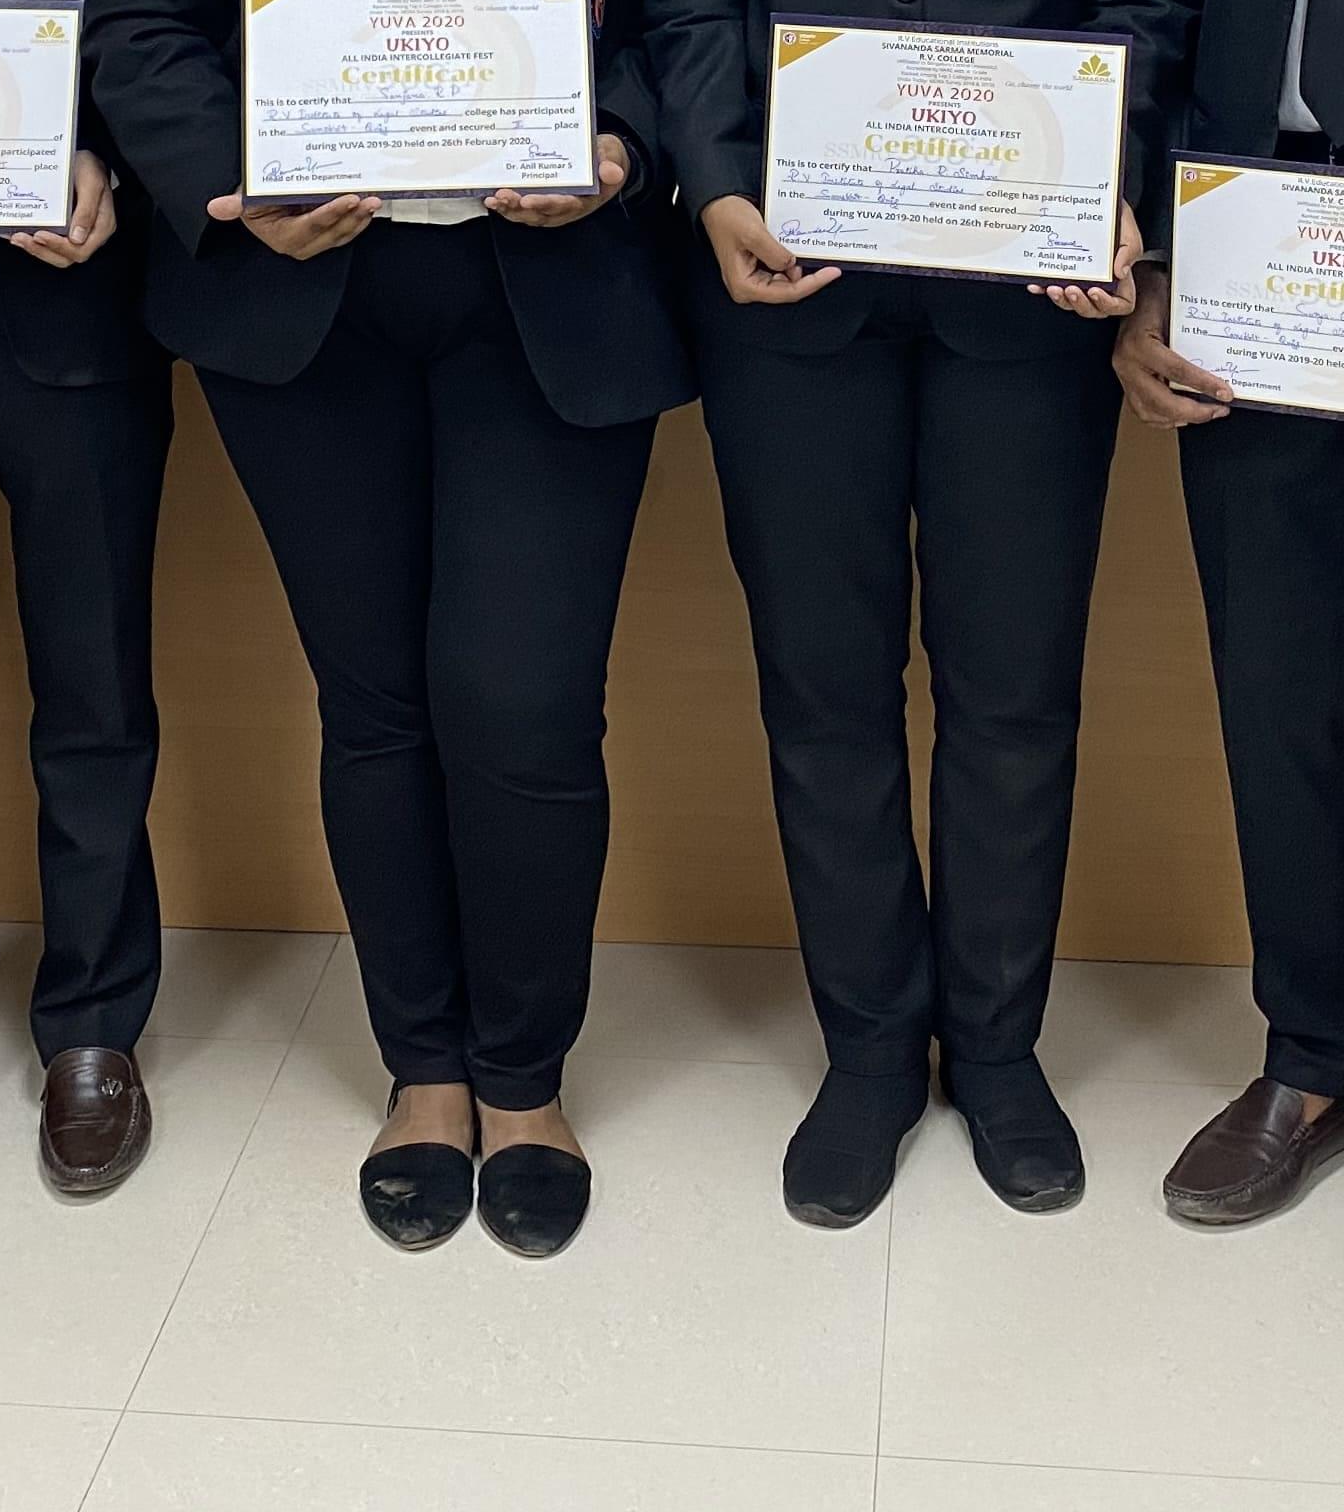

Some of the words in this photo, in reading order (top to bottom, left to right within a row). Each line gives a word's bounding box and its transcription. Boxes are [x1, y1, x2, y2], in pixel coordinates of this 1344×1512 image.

[369, 16, 416, 29] YUVA
[422, 15, 464, 27] 2020
[386, 36, 449, 51] UKIYO
[881, 42, 932, 52] SIVANANDA
[934, 45, 964, 54] SARMA
[967, 47, 1014, 57] MEMORIAL
[360, 54, 387, 62] INDIA
[390, 52, 470, 61] INTERCOLLEGIATE
[473, 51, 493, 59] FEST
[937, 54, 974, 63] COLLEGE
[341, 61, 493, 85] Certificate
[896, 83, 944, 99] YUVA
[950, 87, 994, 102] 2020
[911, 107, 976, 125] UKIYO
[865, 121, 882, 129] ALL
[884, 122, 911, 131] INDIA
[914, 124, 997, 137] INTERCOLLEGIATE
[1000, 130, 1021, 139] FEST
[864, 131, 1020, 163] Certificate
[521, 171, 557, 180] Principal
[776, 157, 794, 166] This
[797, 159, 805, 167] is
[807, 160, 817, 168] to
[819, 160, 850, 172] certify
[852, 163, 872, 172] that
[1098, 181, 1109, 190] of
[1281, 183, 1332, 195] SIVANANDA
[986, 189, 1020, 200] college
[1022, 191, 1039, 200] has
[1041, 193, 1100, 206] participated
[1319, 196, 1336, 204] R.V.
[823, 208, 854, 218] during
[856, 211, 882, 219] YUVA
[884, 213, 920, 222] 2019-20
[922, 215, 942, 224] held
[960, 218, 981, 227] 26th
[983, 220, 1026, 231] February
[928, 201, 956, 210] event
[958, 202, 976, 211] and
[979, 204, 1016, 214] secured
[1077, 211, 1103, 223] place
[1297, 225, 1344, 243] YUVA
[802, 237, 810, 245] of
[827, 240, 877, 252] Department
[1267, 262, 1283, 271] ALL
[1286, 264, 1313, 274] INDIA
